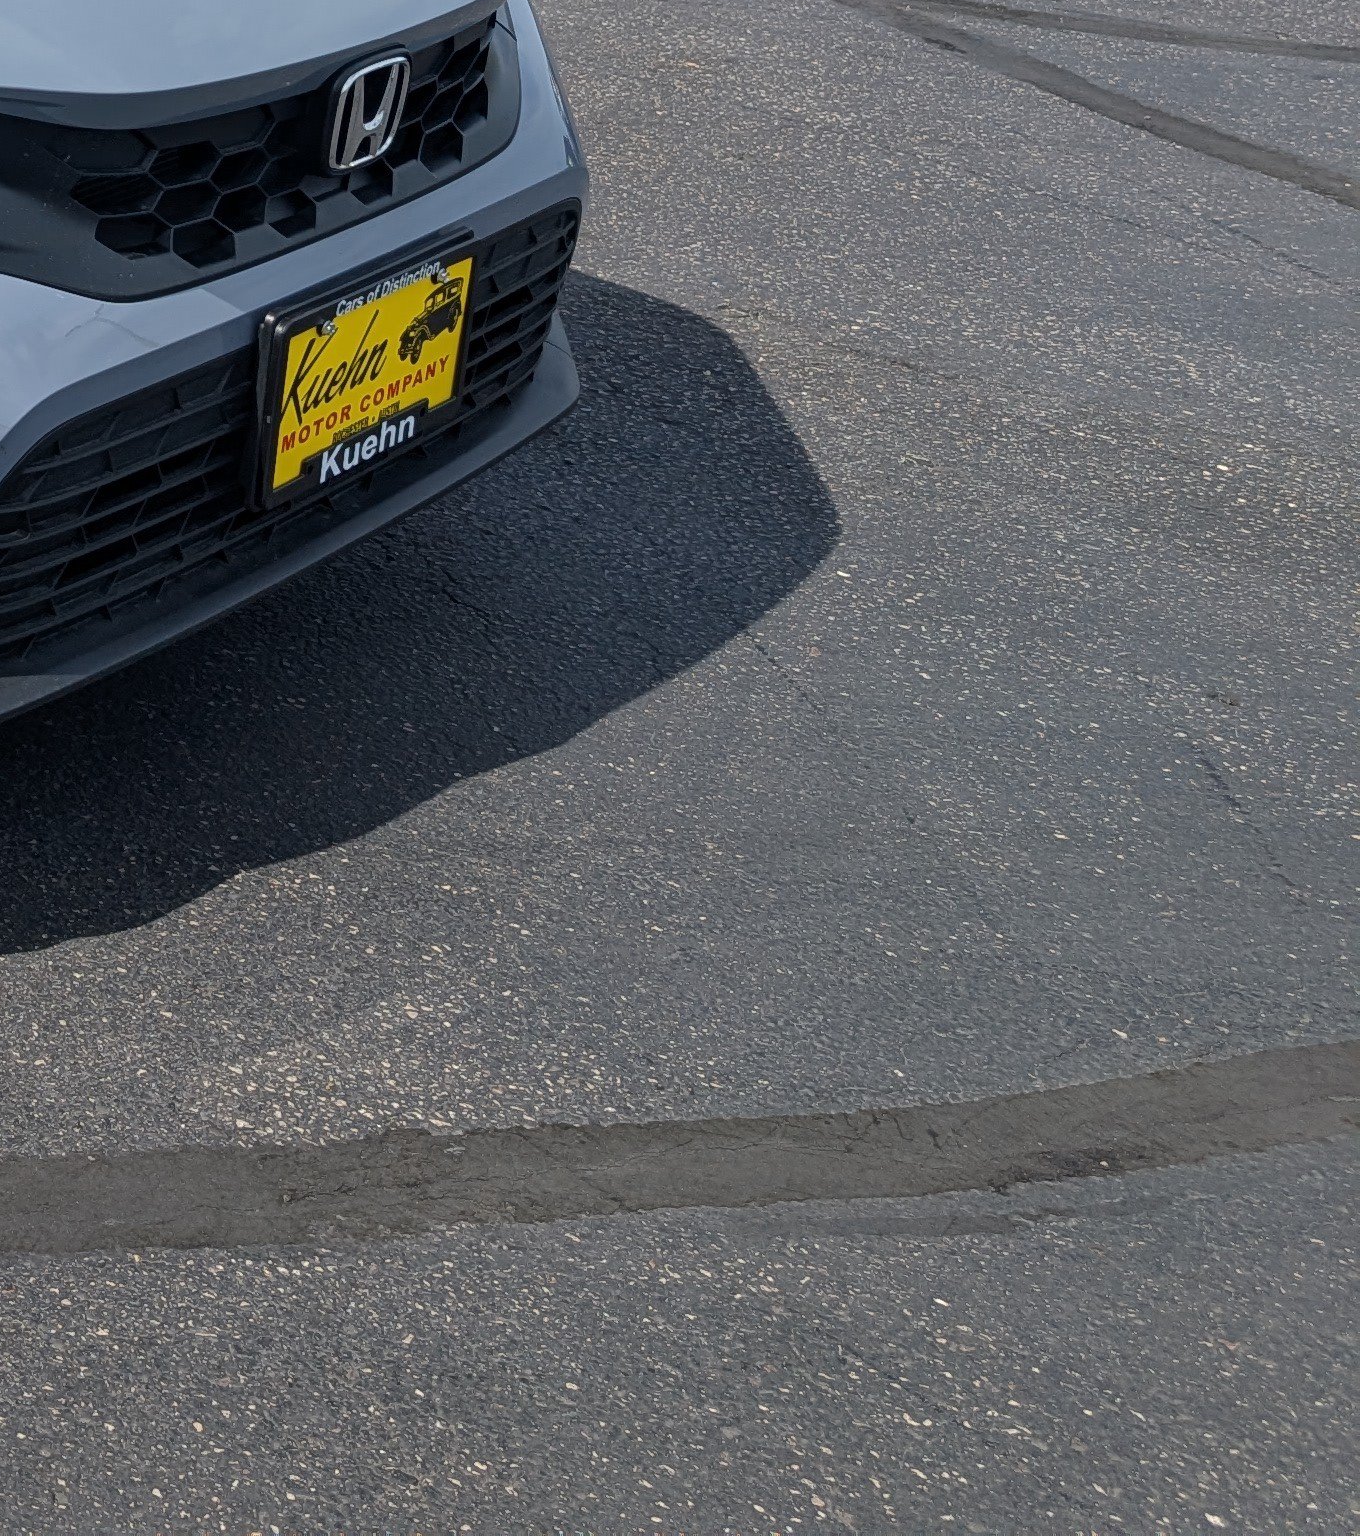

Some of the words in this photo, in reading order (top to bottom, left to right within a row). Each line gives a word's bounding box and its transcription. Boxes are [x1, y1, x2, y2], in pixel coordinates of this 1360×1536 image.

[335, 293, 364, 317] Cars
[366, 286, 381, 305] of
[381, 261, 442, 296] Distinction
[280, 308, 390, 427] Kuehn
[281, 404, 352, 454] MOTOR
[359, 354, 450, 413] COMPANY
[319, 414, 416, 485] Kuehn
